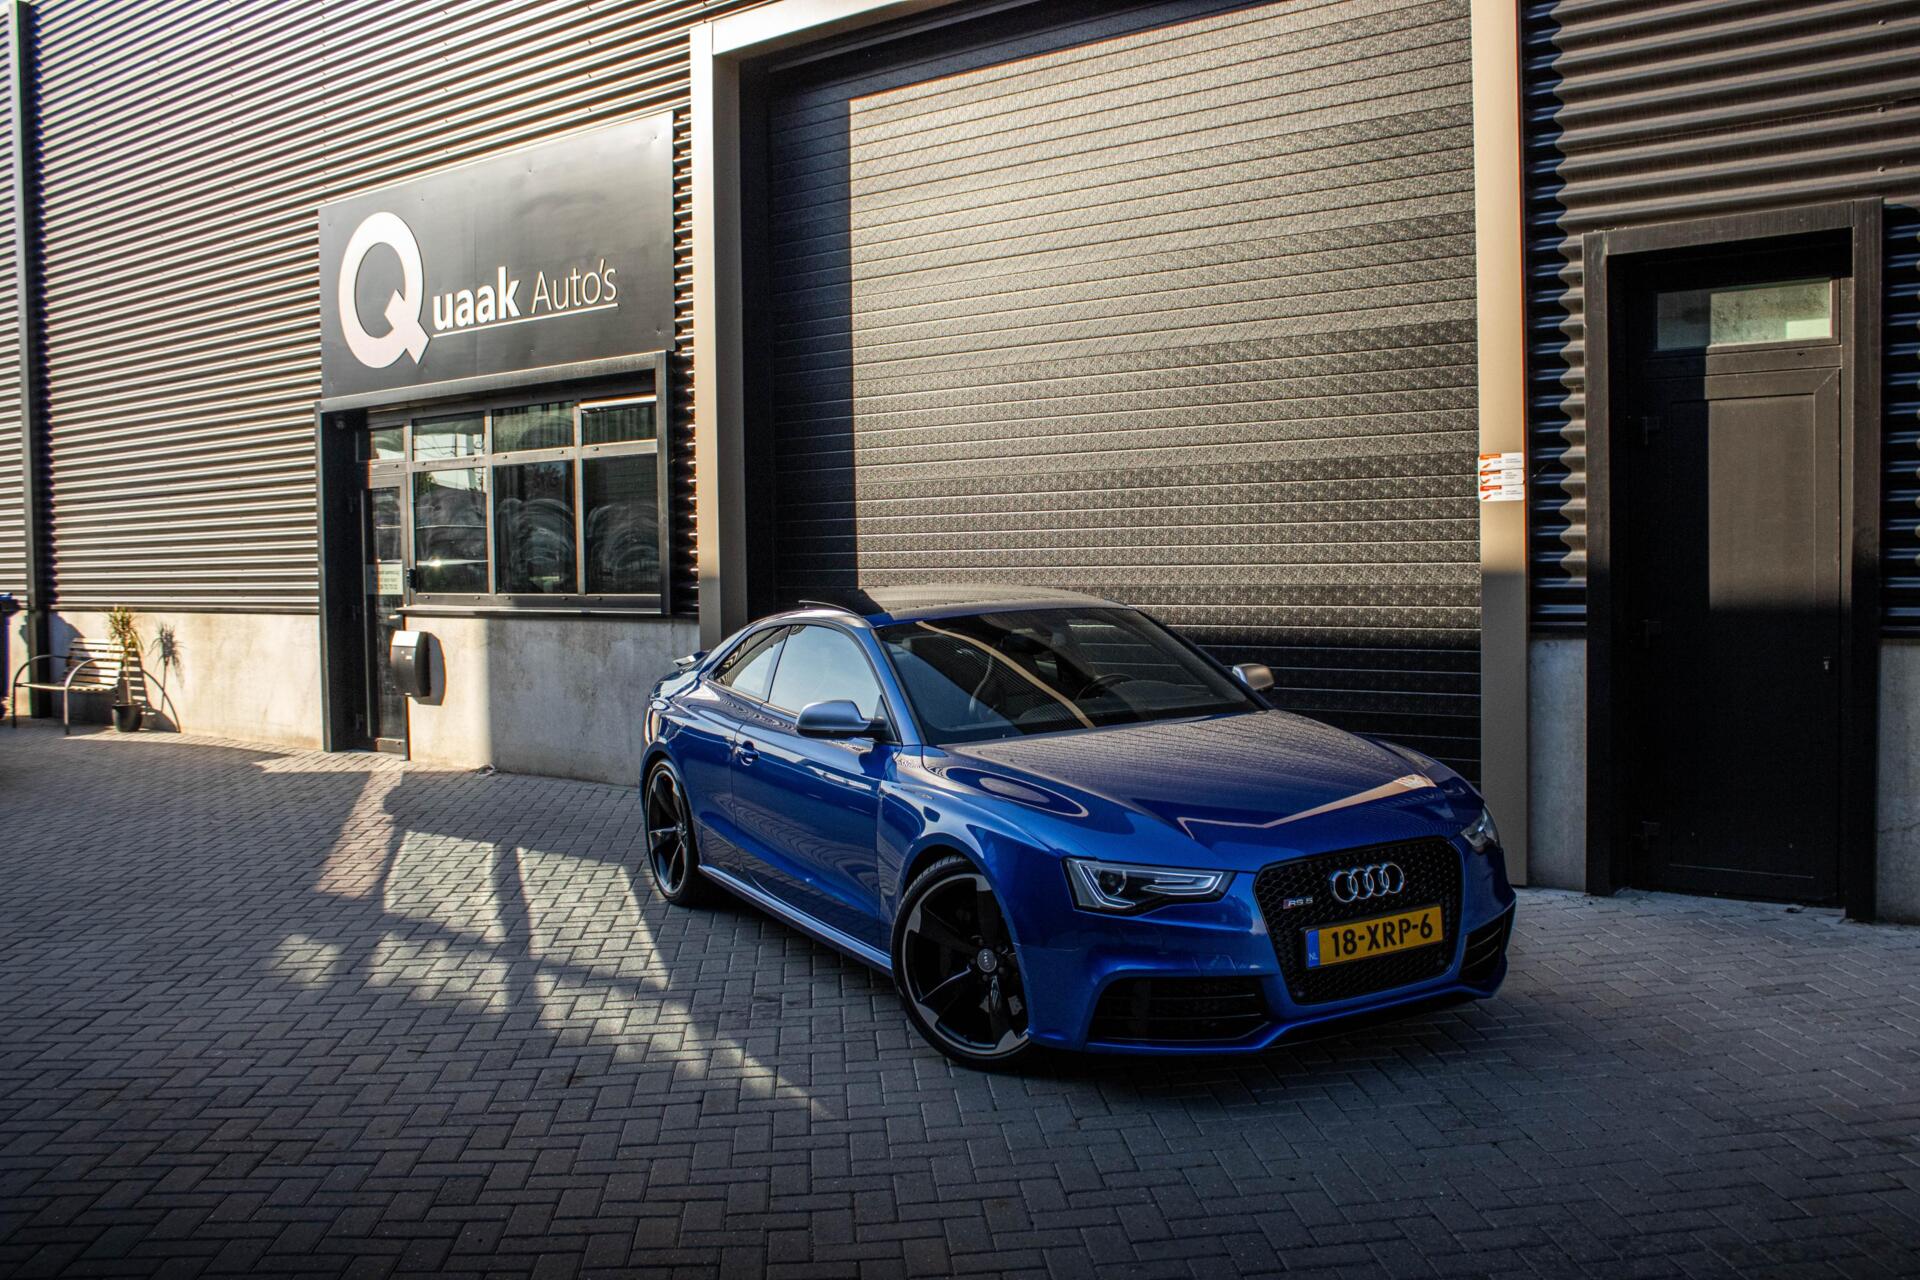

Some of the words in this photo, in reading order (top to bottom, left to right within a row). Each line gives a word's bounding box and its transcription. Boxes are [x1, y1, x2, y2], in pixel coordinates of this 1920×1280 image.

[338, 211, 521, 368] Quaak
[531, 258, 618, 314] Auto's
[1331, 913, 1433, 957] 18-XRP-6
